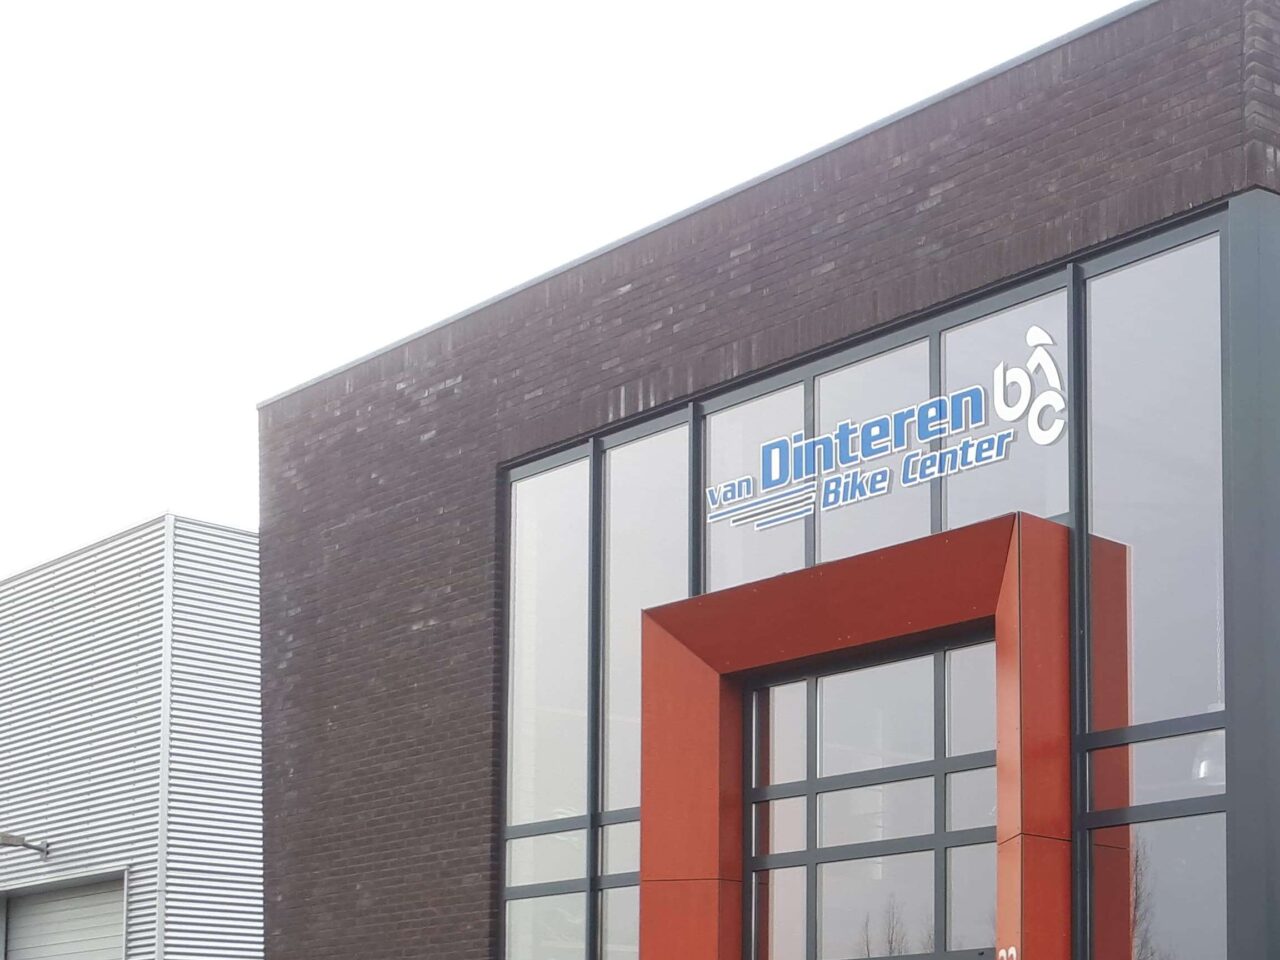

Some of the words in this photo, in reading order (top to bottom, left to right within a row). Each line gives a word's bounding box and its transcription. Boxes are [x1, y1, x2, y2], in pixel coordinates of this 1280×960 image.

[706, 475, 752, 508] van
[760, 384, 986, 492] Dinteren
[821, 468, 889, 511] Bike
[900, 428, 1014, 488] Center
